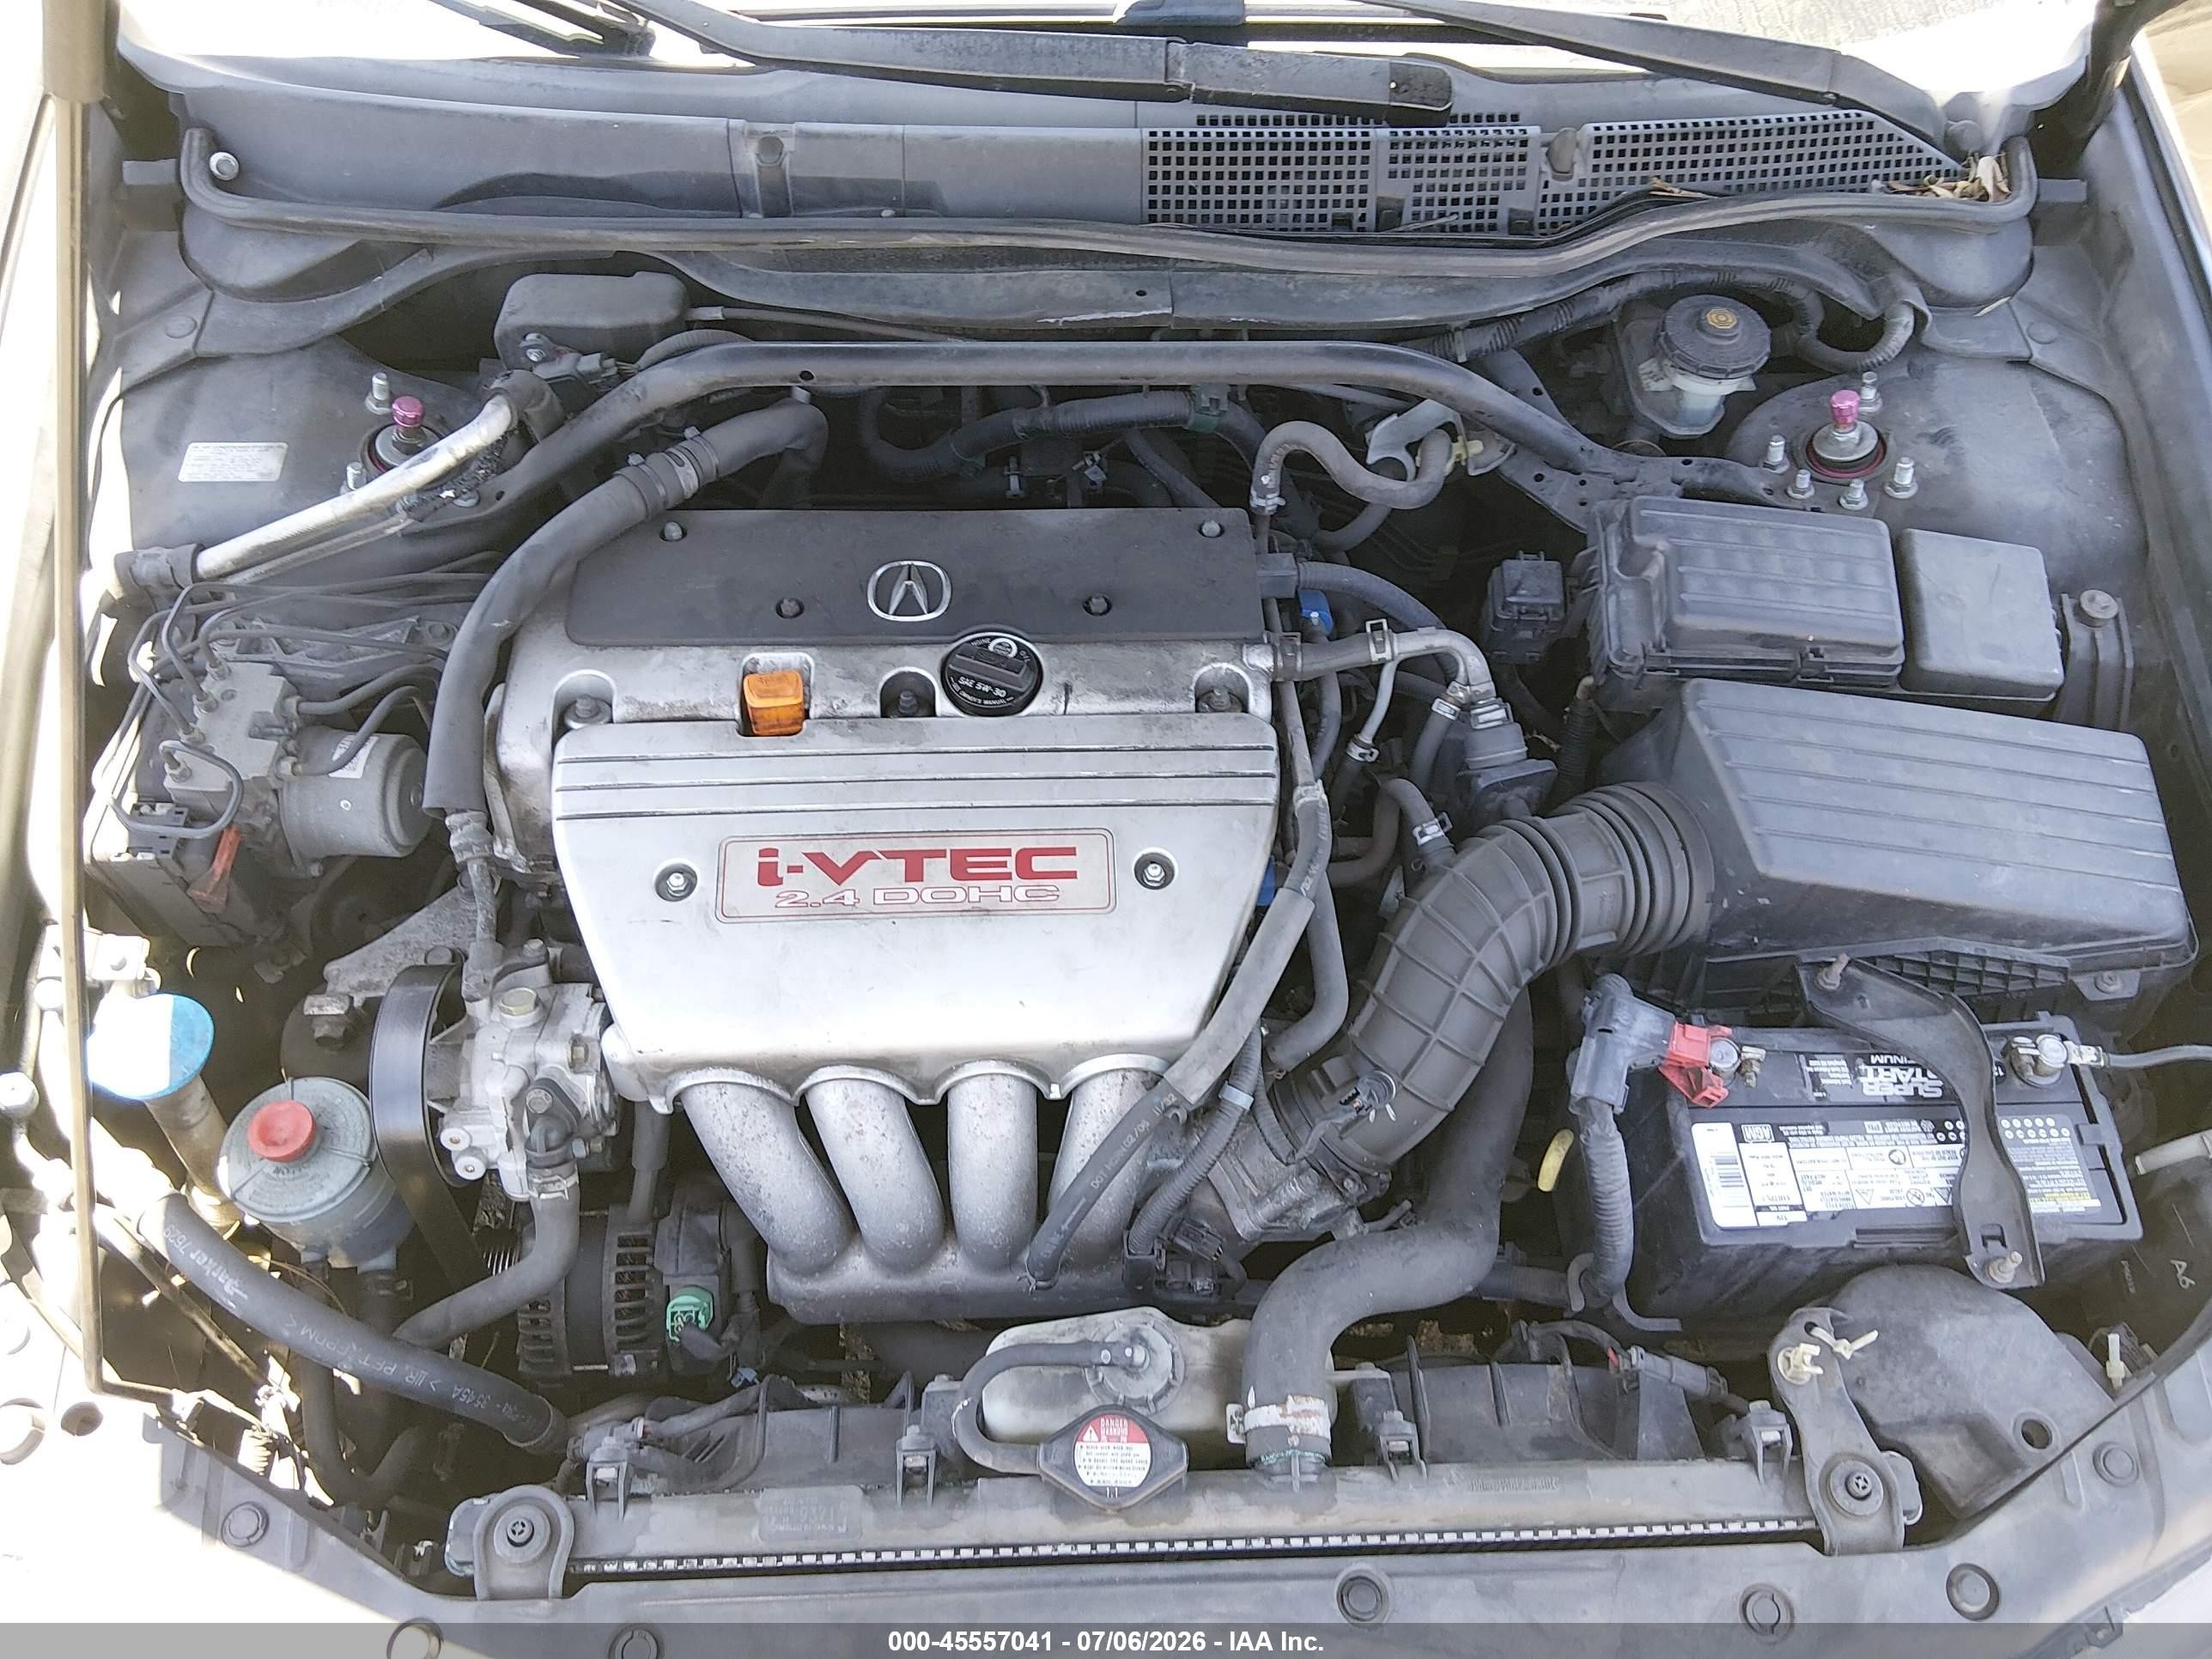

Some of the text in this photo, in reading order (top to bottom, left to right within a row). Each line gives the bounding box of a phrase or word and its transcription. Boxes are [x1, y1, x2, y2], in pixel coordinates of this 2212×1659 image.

[957, 676, 975, 688] SAE
[757, 846, 1078, 887] i-VTEC
[775, 884, 1060, 908] 2.4 DOHC
[1862, 1079, 1943, 1098] SUPER
[1742, 1126, 1771, 1141] AGM
